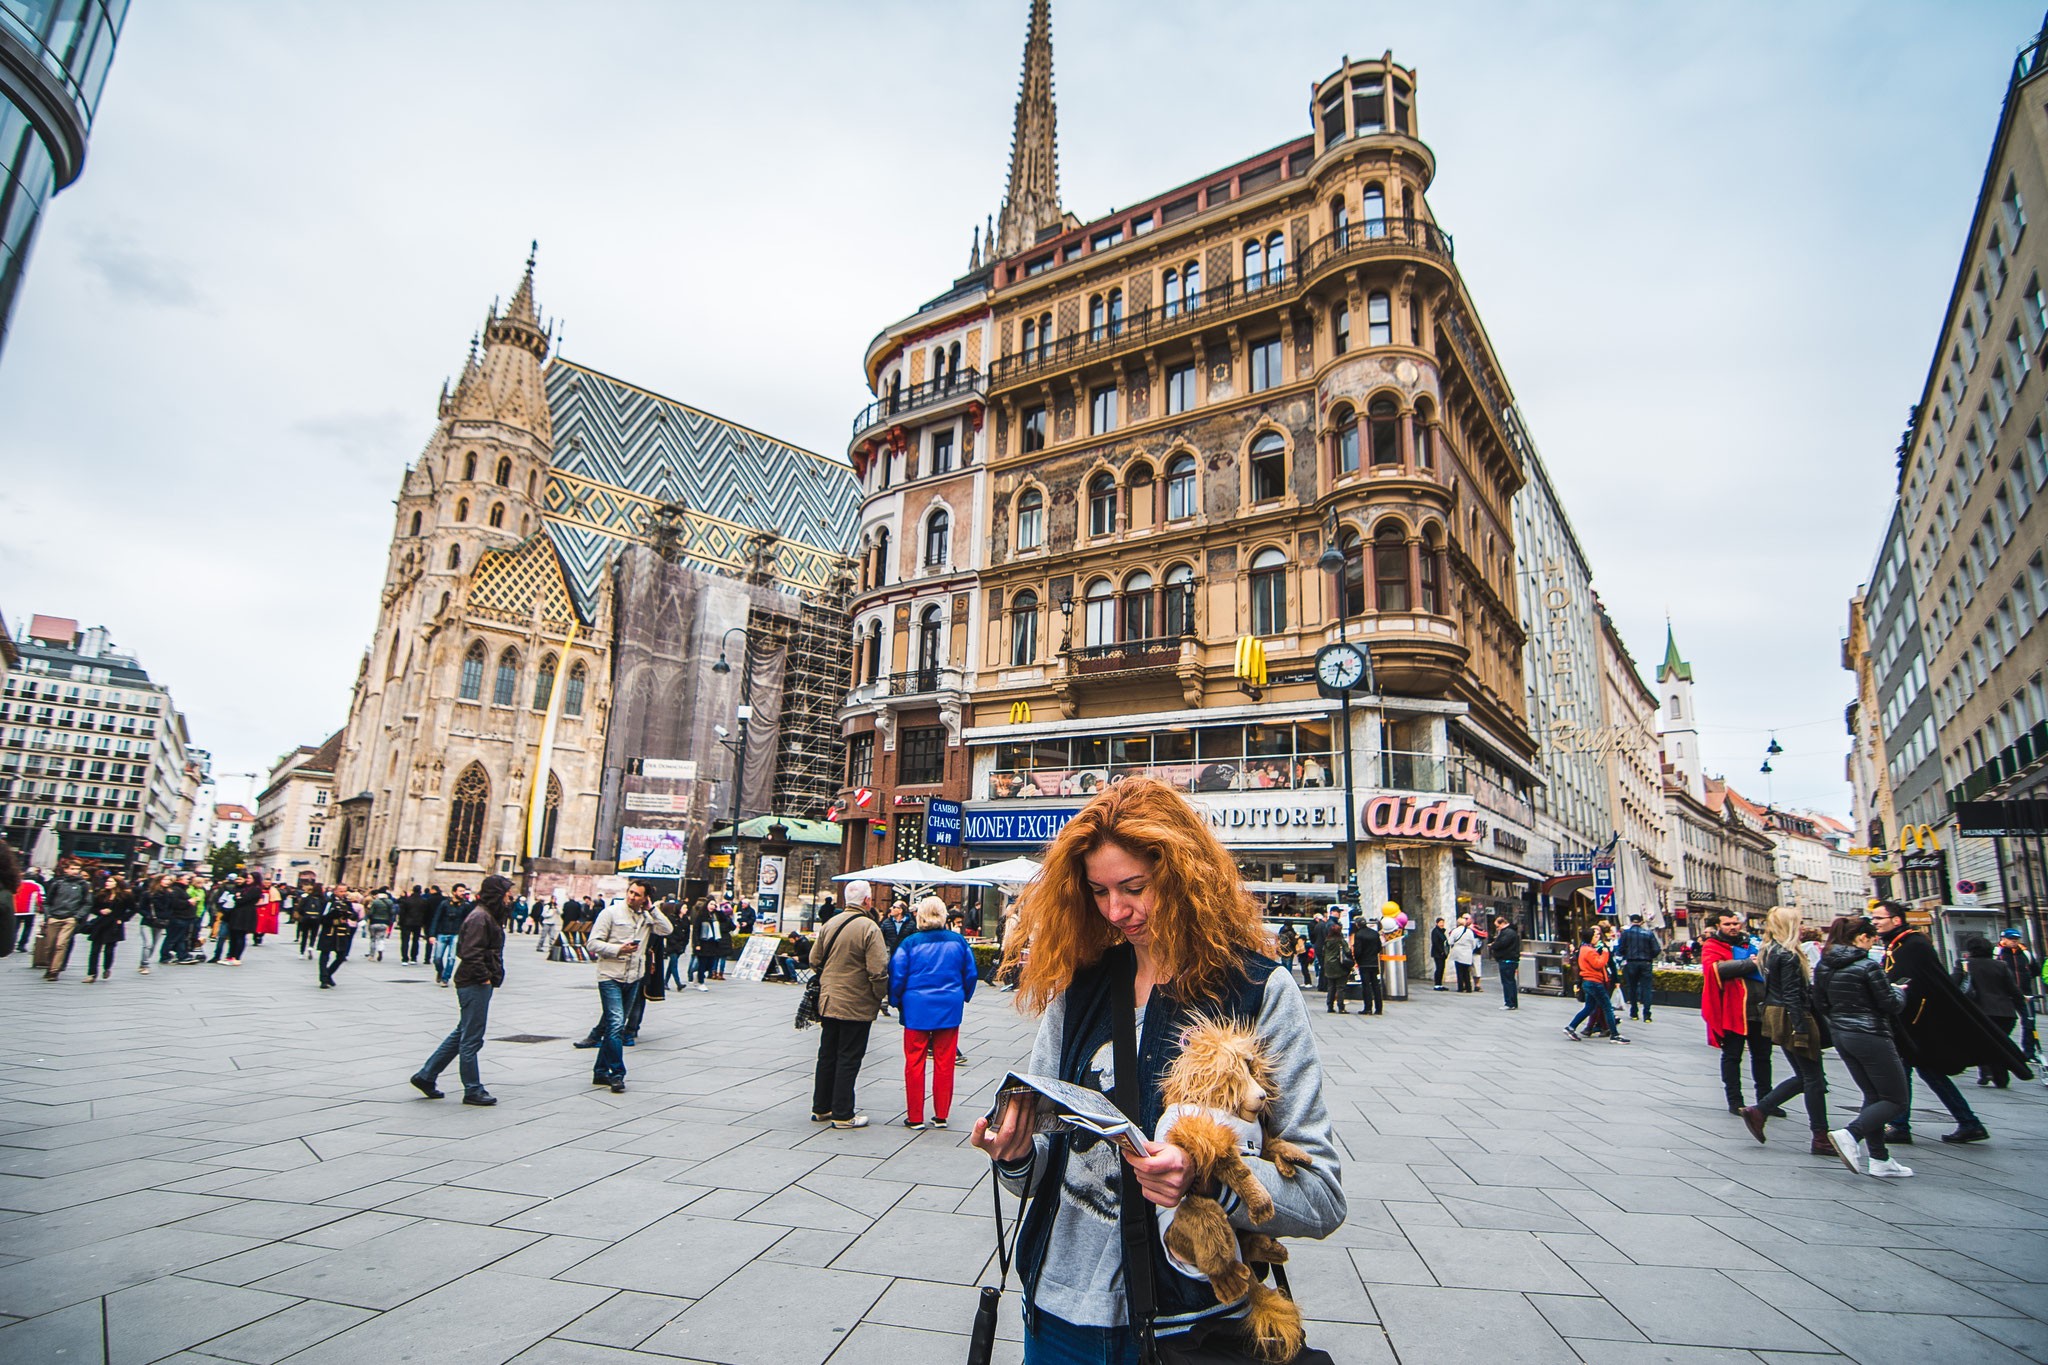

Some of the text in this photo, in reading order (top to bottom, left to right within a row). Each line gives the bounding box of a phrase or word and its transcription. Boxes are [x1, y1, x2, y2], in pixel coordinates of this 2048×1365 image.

[1542, 556, 1575, 707] HOTEL
[1550, 713, 1650, 768] Royal
[933, 802, 958, 814] CAMBIO
[928, 815, 961, 830] CHANGE
[964, 816, 1014, 838] MONEY
[1962, 828, 2007, 836] HUMANIC
